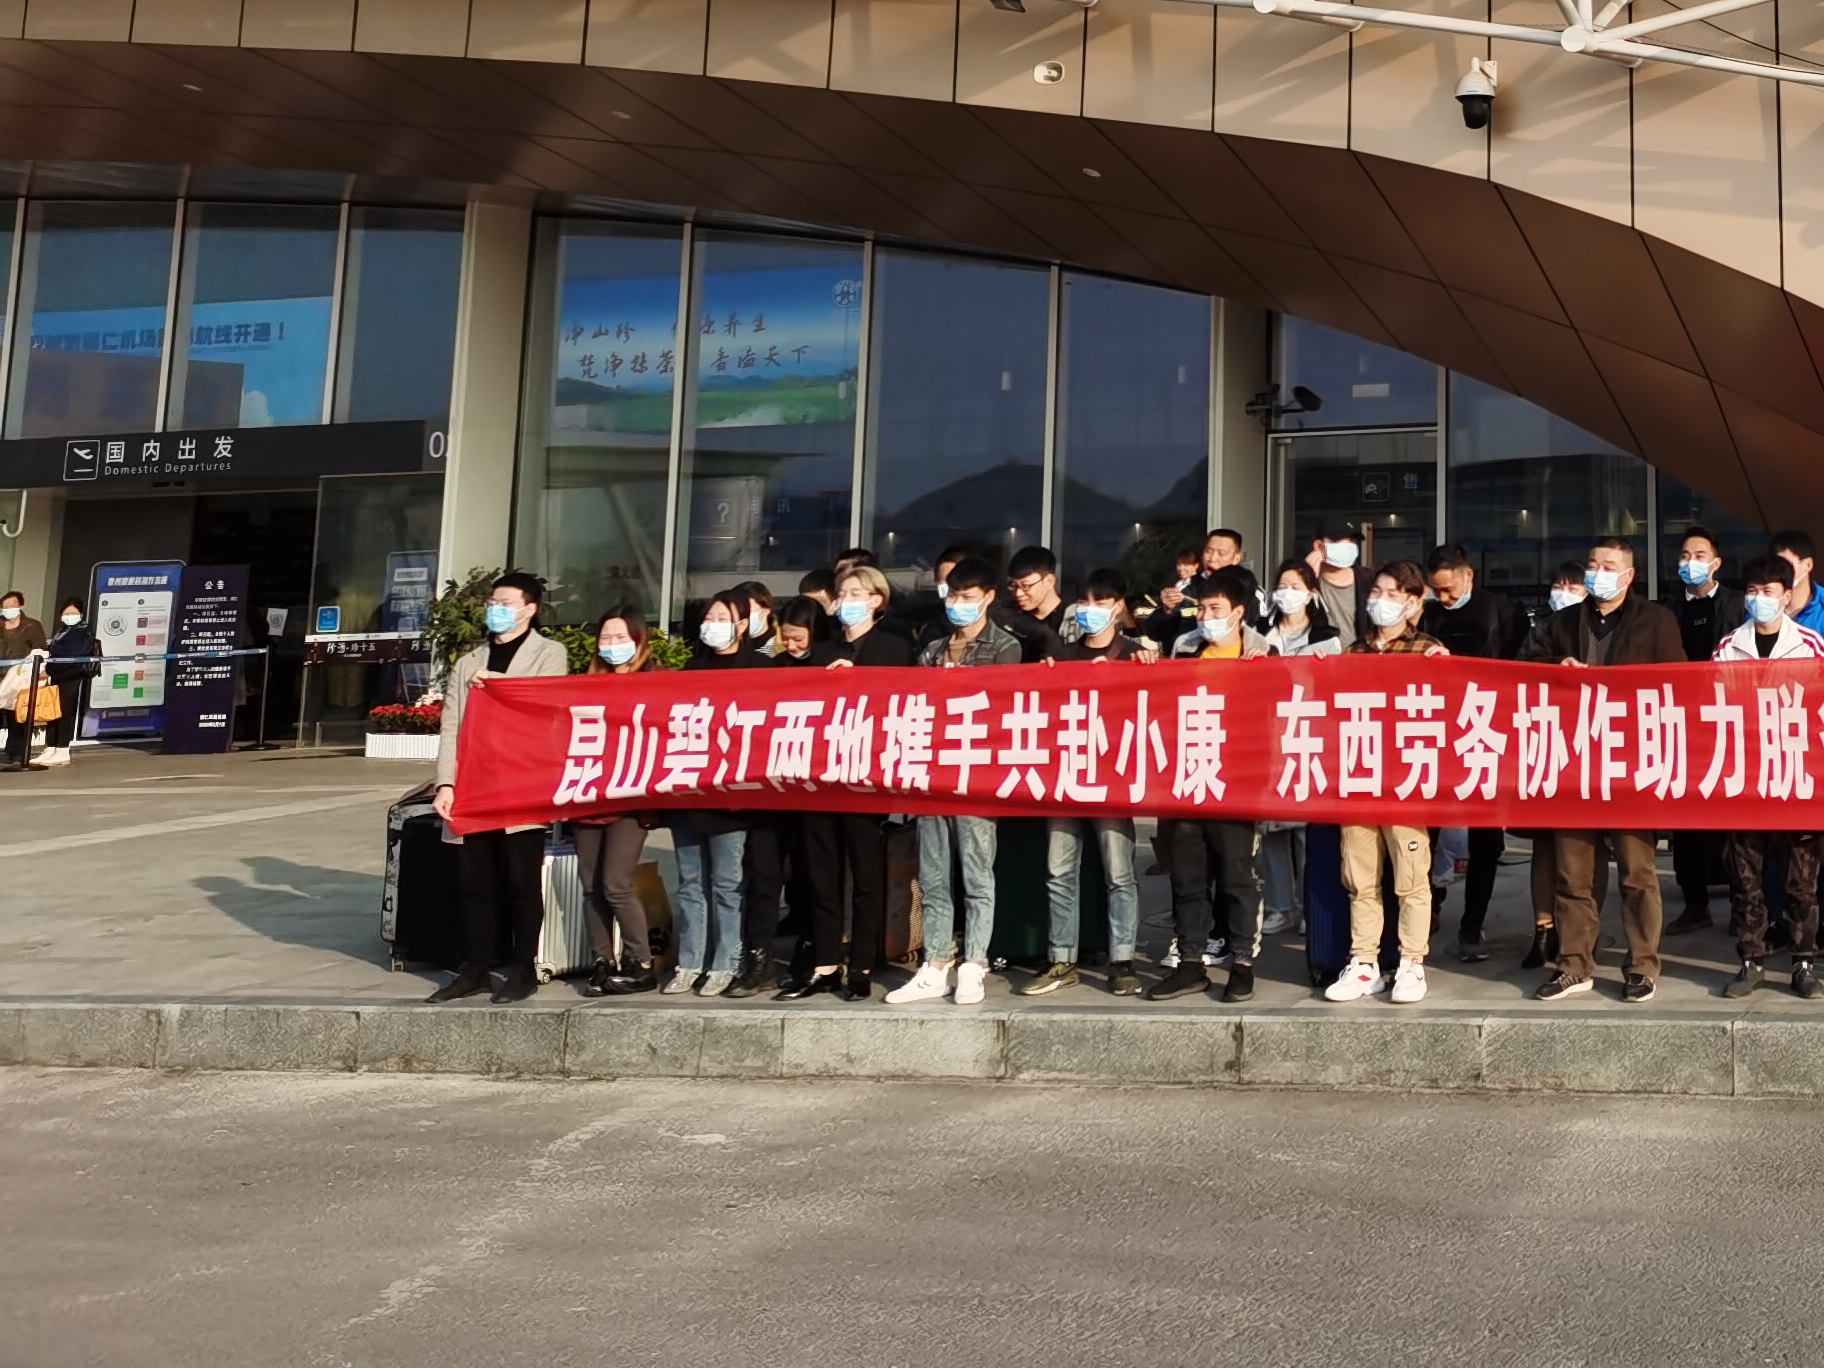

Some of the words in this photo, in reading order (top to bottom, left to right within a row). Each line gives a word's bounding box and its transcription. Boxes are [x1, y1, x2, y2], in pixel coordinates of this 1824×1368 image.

[105, 435, 235, 464] 国内出发
[104, 463, 159, 476] Domestic
[165, 461, 231, 475] Departures
[204, 579, 225, 590] 公告
[552, 686, 1228, 806] 昆山碧江两地携手共赴小康
